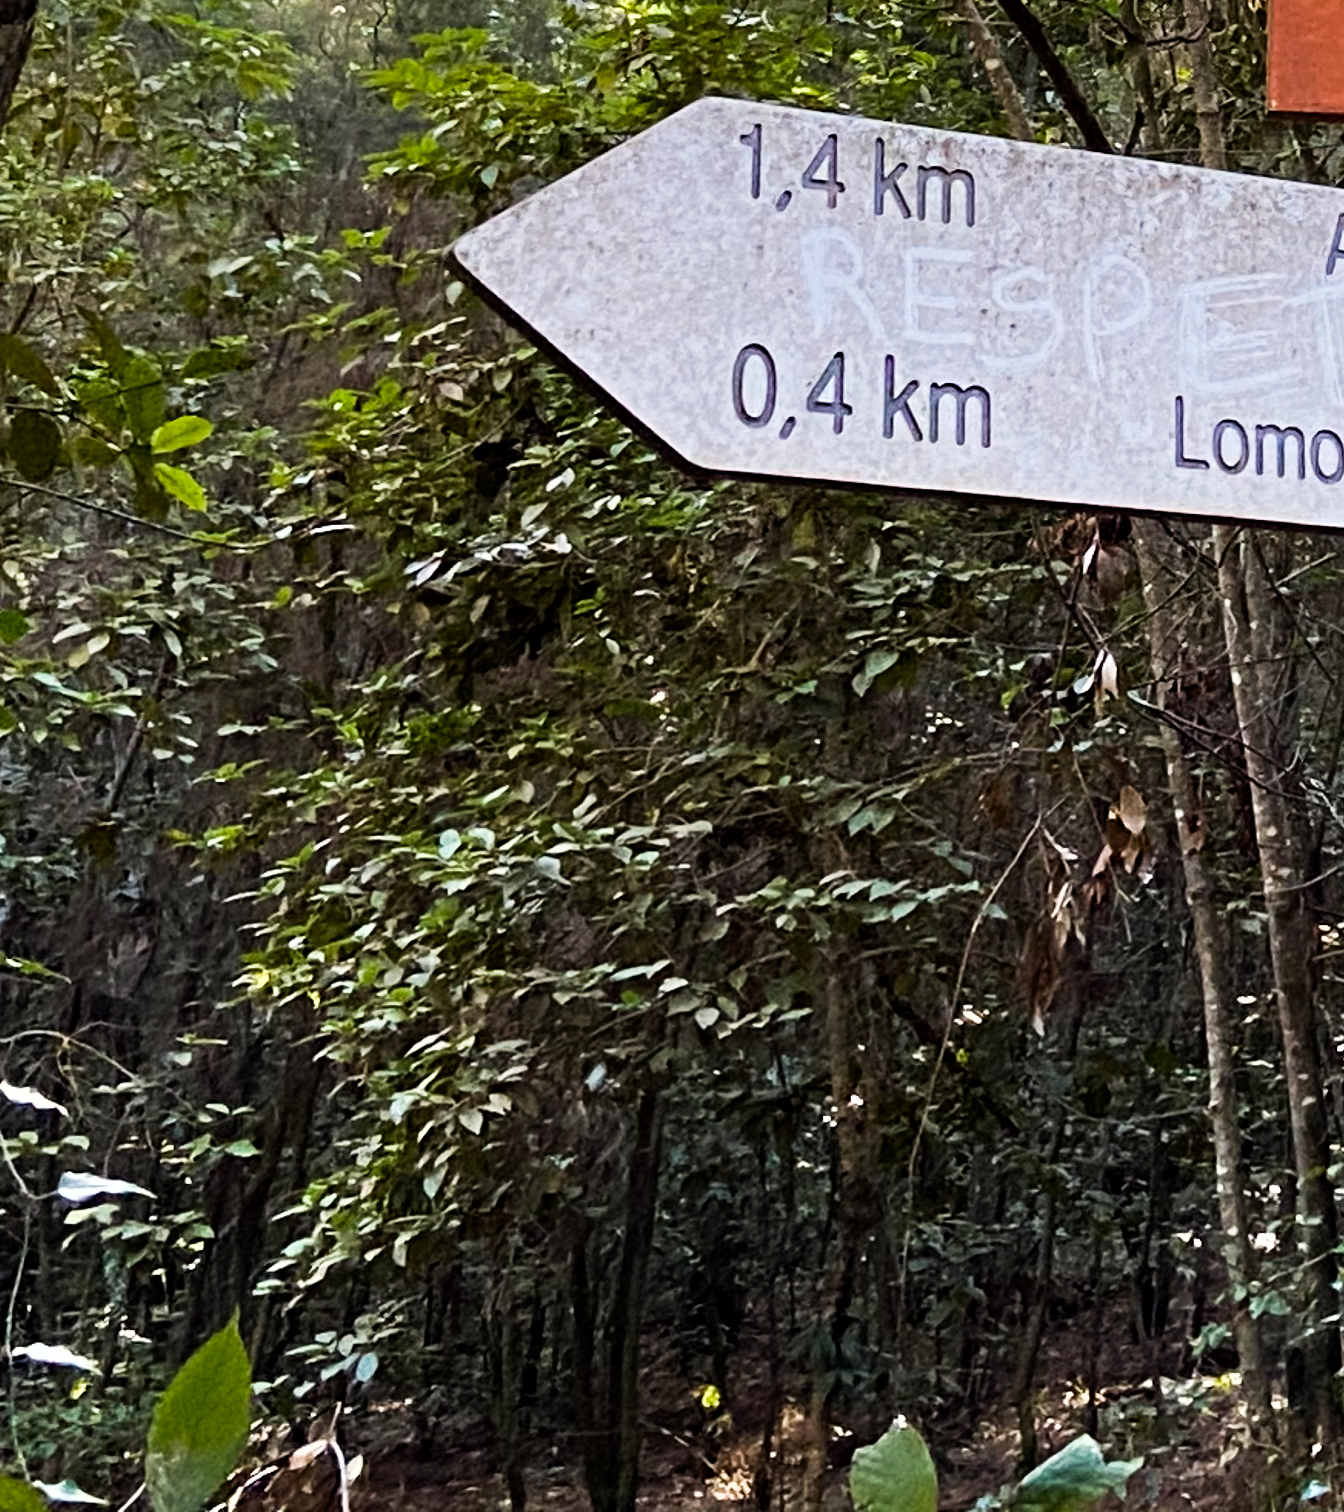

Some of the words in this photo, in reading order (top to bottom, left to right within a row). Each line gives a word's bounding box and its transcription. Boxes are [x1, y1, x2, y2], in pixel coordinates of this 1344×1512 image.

[739, 123, 847, 213] 1,4
[873, 137, 976, 228] km
[731, 342, 854, 440] 0,4
[882, 354, 992, 449] km
